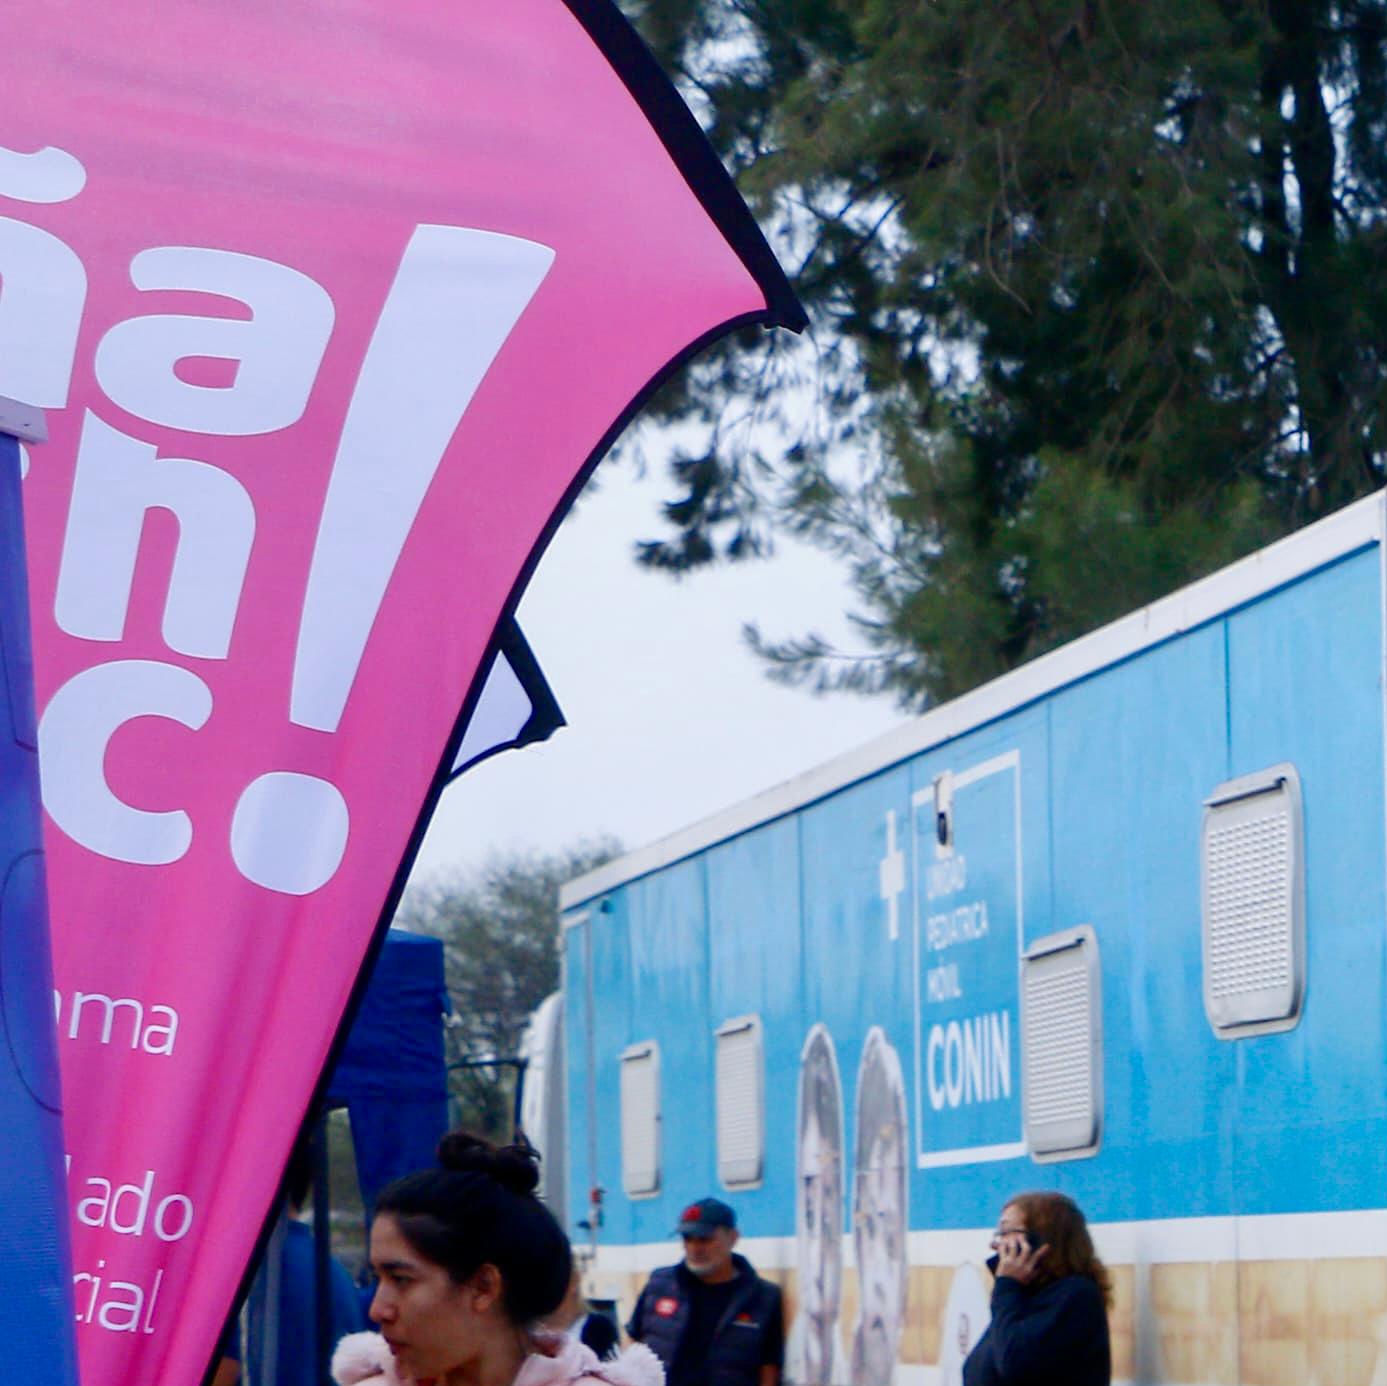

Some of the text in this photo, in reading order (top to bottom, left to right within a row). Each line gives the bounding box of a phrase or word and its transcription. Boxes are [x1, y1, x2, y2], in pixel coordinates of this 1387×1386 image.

[53, 988, 179, 1056] ma
[927, 1010, 1010, 1110] CONIN
[65, 1154, 193, 1241] ado
